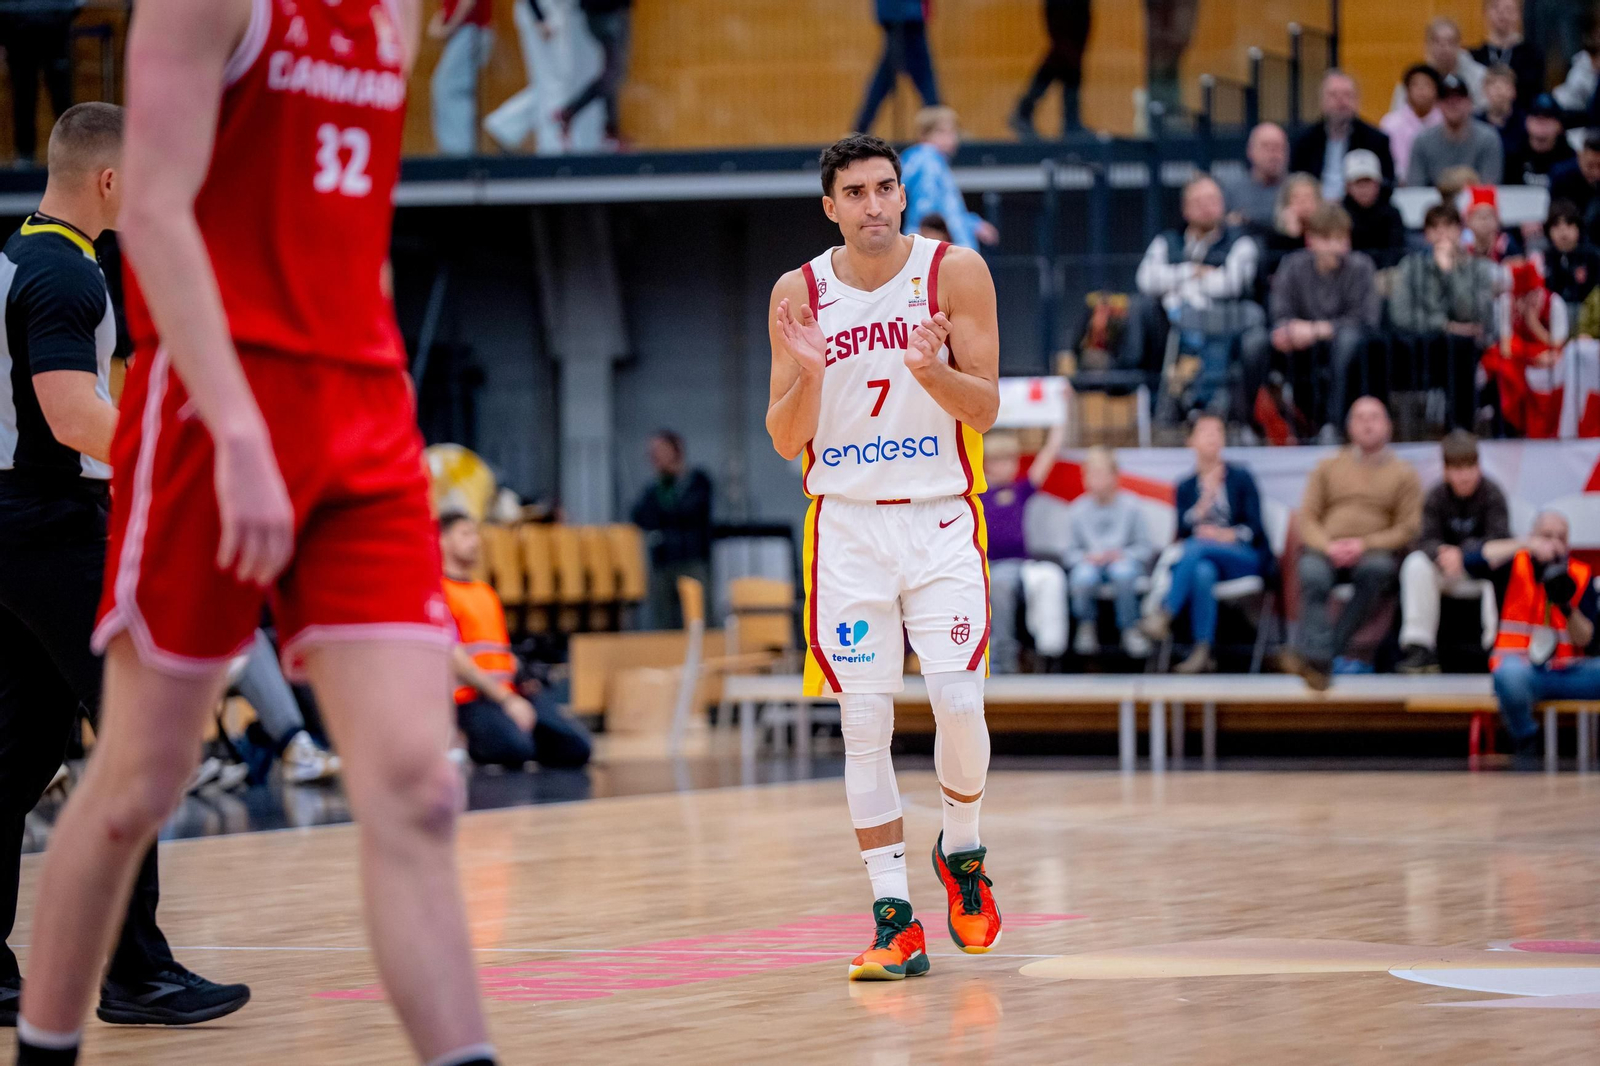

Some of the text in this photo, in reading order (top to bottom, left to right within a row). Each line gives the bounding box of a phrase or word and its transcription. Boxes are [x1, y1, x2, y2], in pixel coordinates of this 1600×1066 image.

[313, 122, 372, 197] 32
[825, 317, 919, 368] ESPAÑ
[867, 378, 890, 417] 7
[822, 435, 939, 467] endesa
